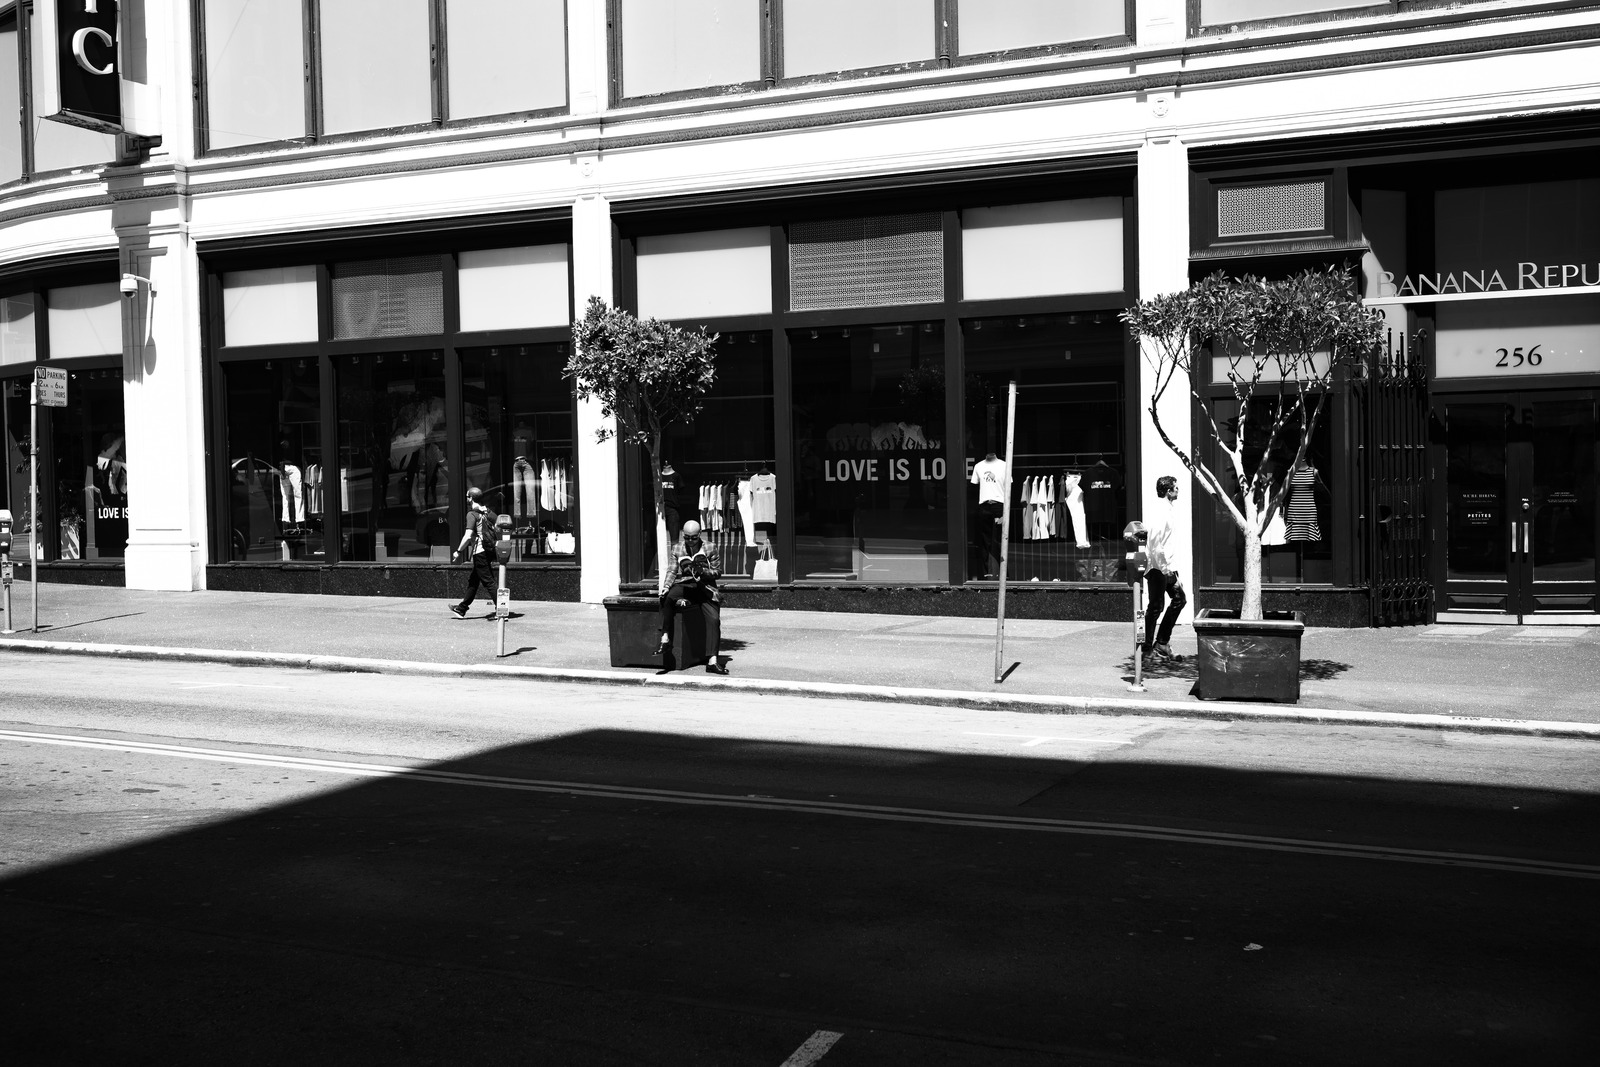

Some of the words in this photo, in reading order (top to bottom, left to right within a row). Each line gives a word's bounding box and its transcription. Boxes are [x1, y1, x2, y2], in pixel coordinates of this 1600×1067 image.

[1376, 269, 1507, 298] BANANA
[1495, 344, 1543, 367] 256
[37, 367, 46, 378] NO
[47, 371, 65, 380] PARKING
[825, 458, 878, 481] LOVE
[889, 458, 910, 481] IS
[920, 457, 976, 481] LOE
[98, 507, 119, 519] LOVE
